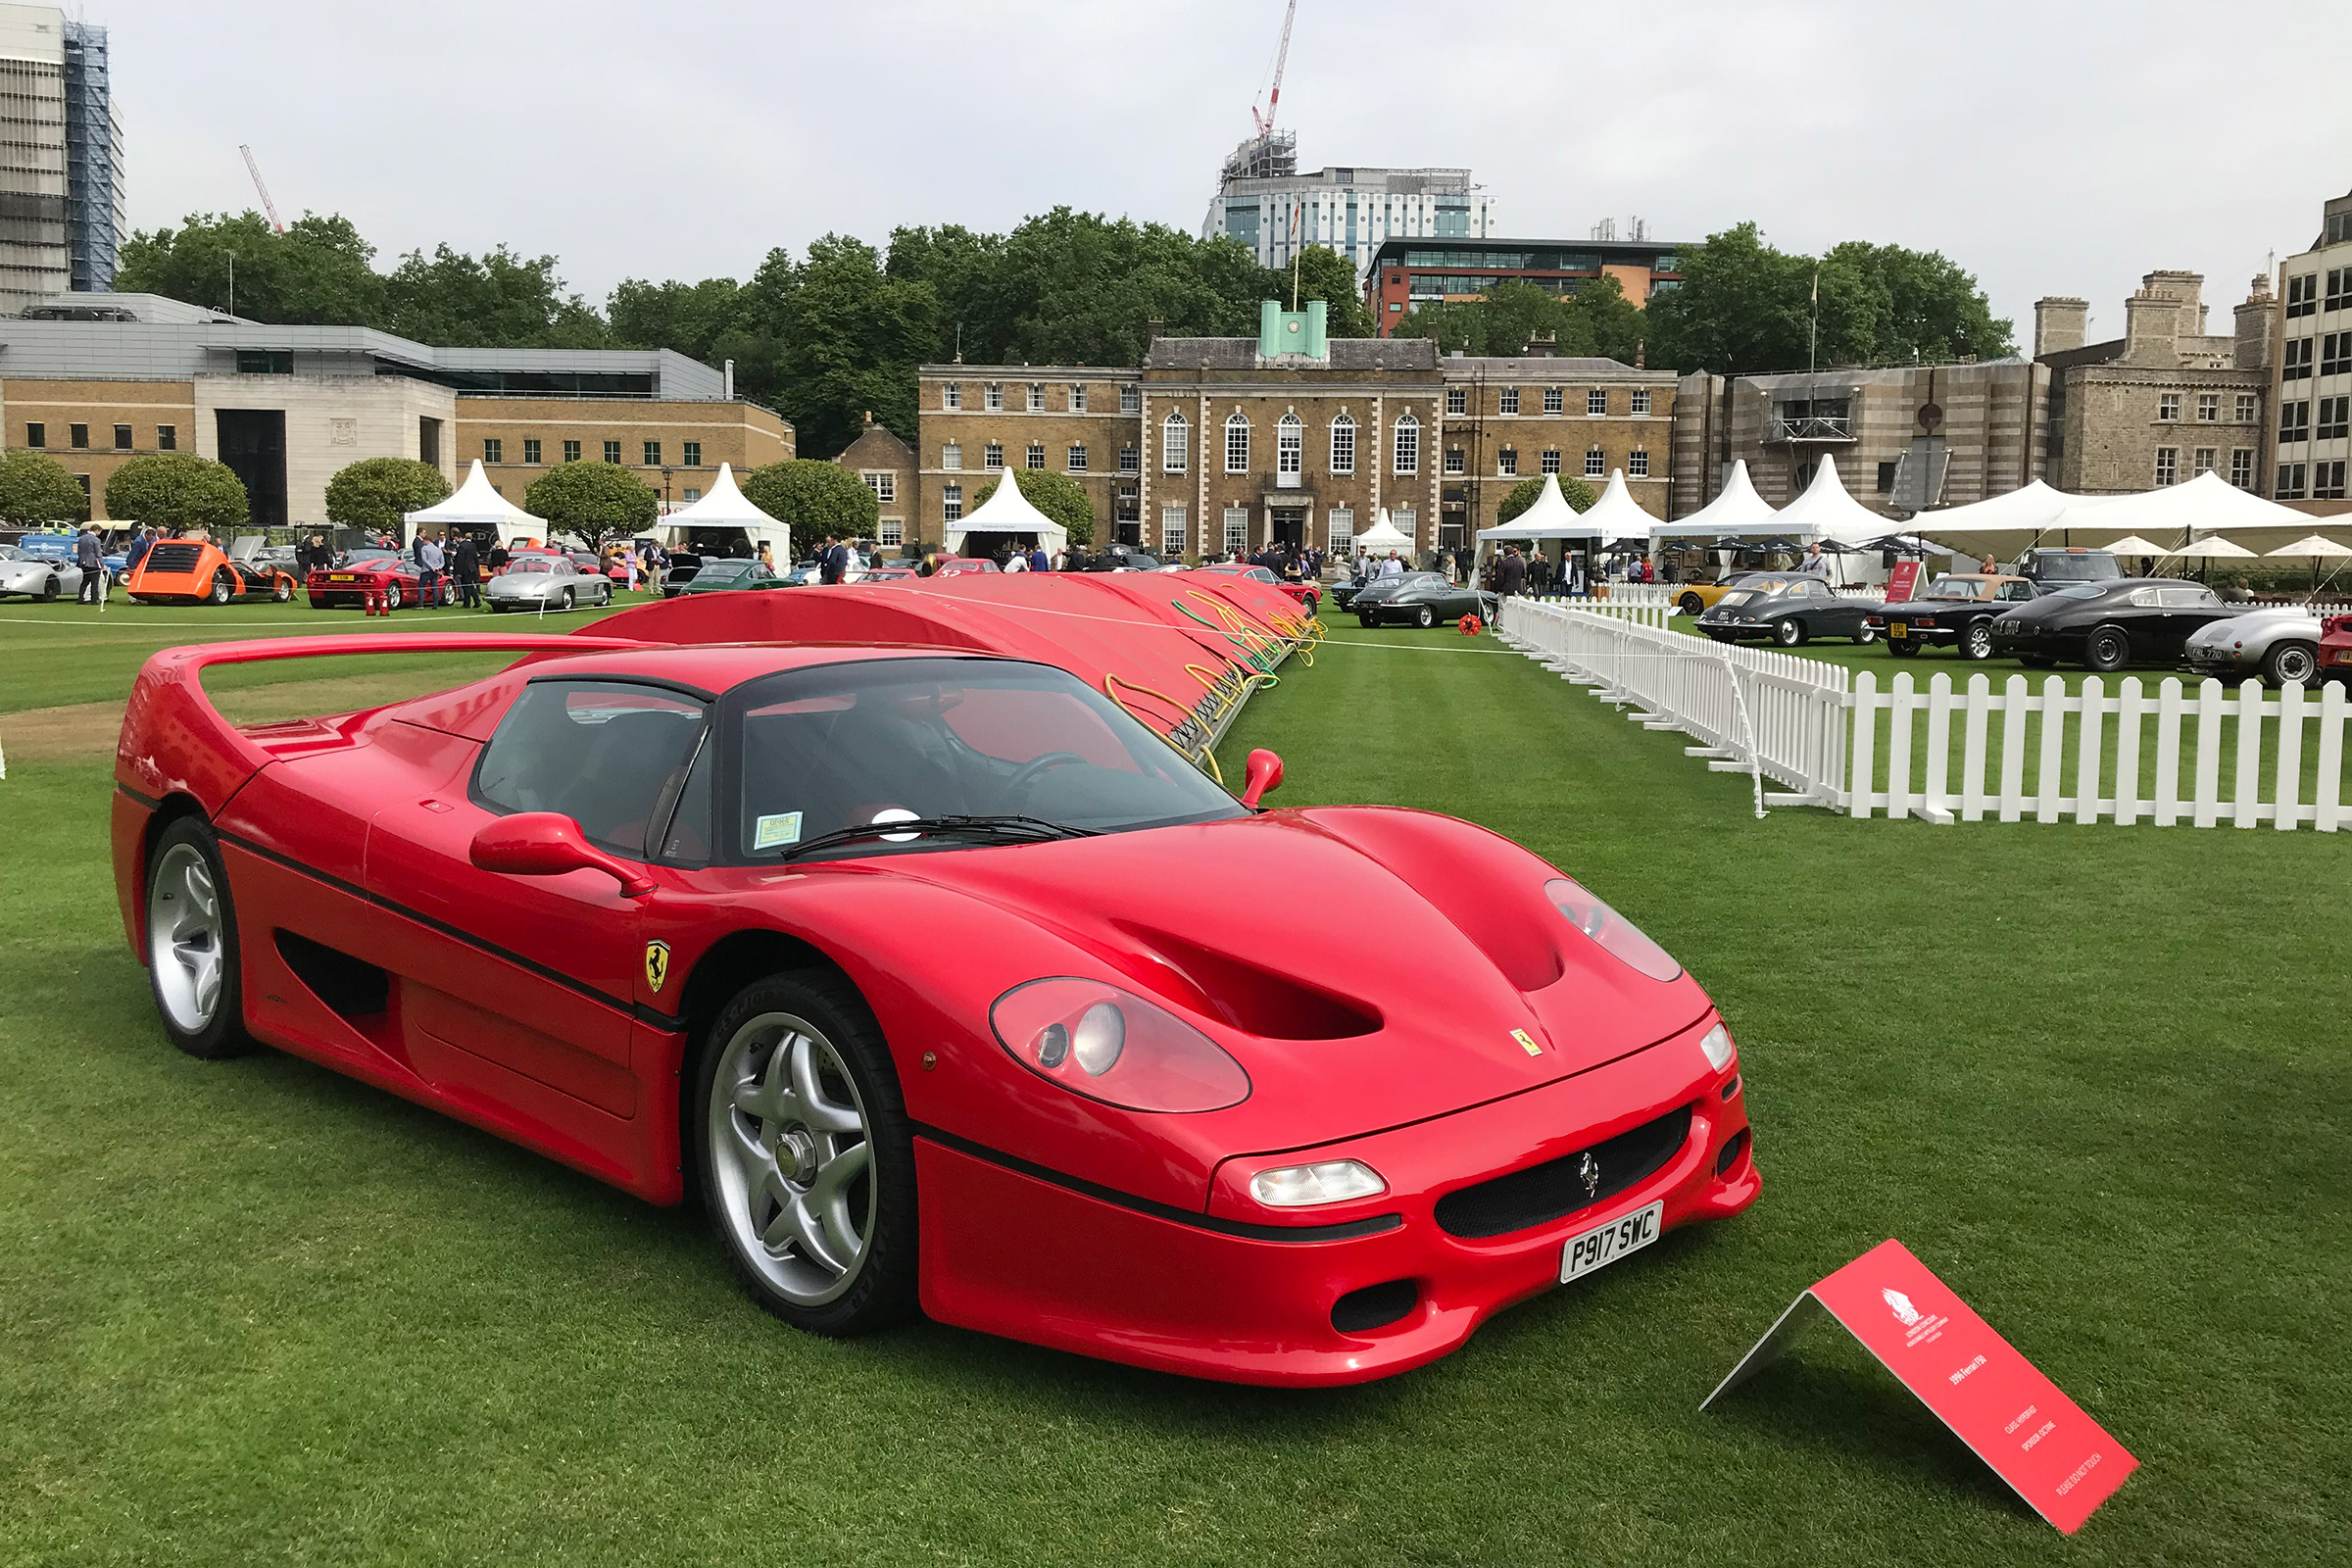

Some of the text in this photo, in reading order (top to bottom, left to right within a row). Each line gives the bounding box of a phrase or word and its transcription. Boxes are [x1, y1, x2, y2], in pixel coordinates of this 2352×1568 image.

[939, 569, 961, 578] 52
[1571, 1209, 1654, 1273] P917 SWC
[1949, 1354, 1987, 1385] 1996 Ferrari F50
[2038, 1421, 2056, 1437] OCTANE
[2056, 1452, 2102, 1496] PLEASE DO NOT TOUCH
